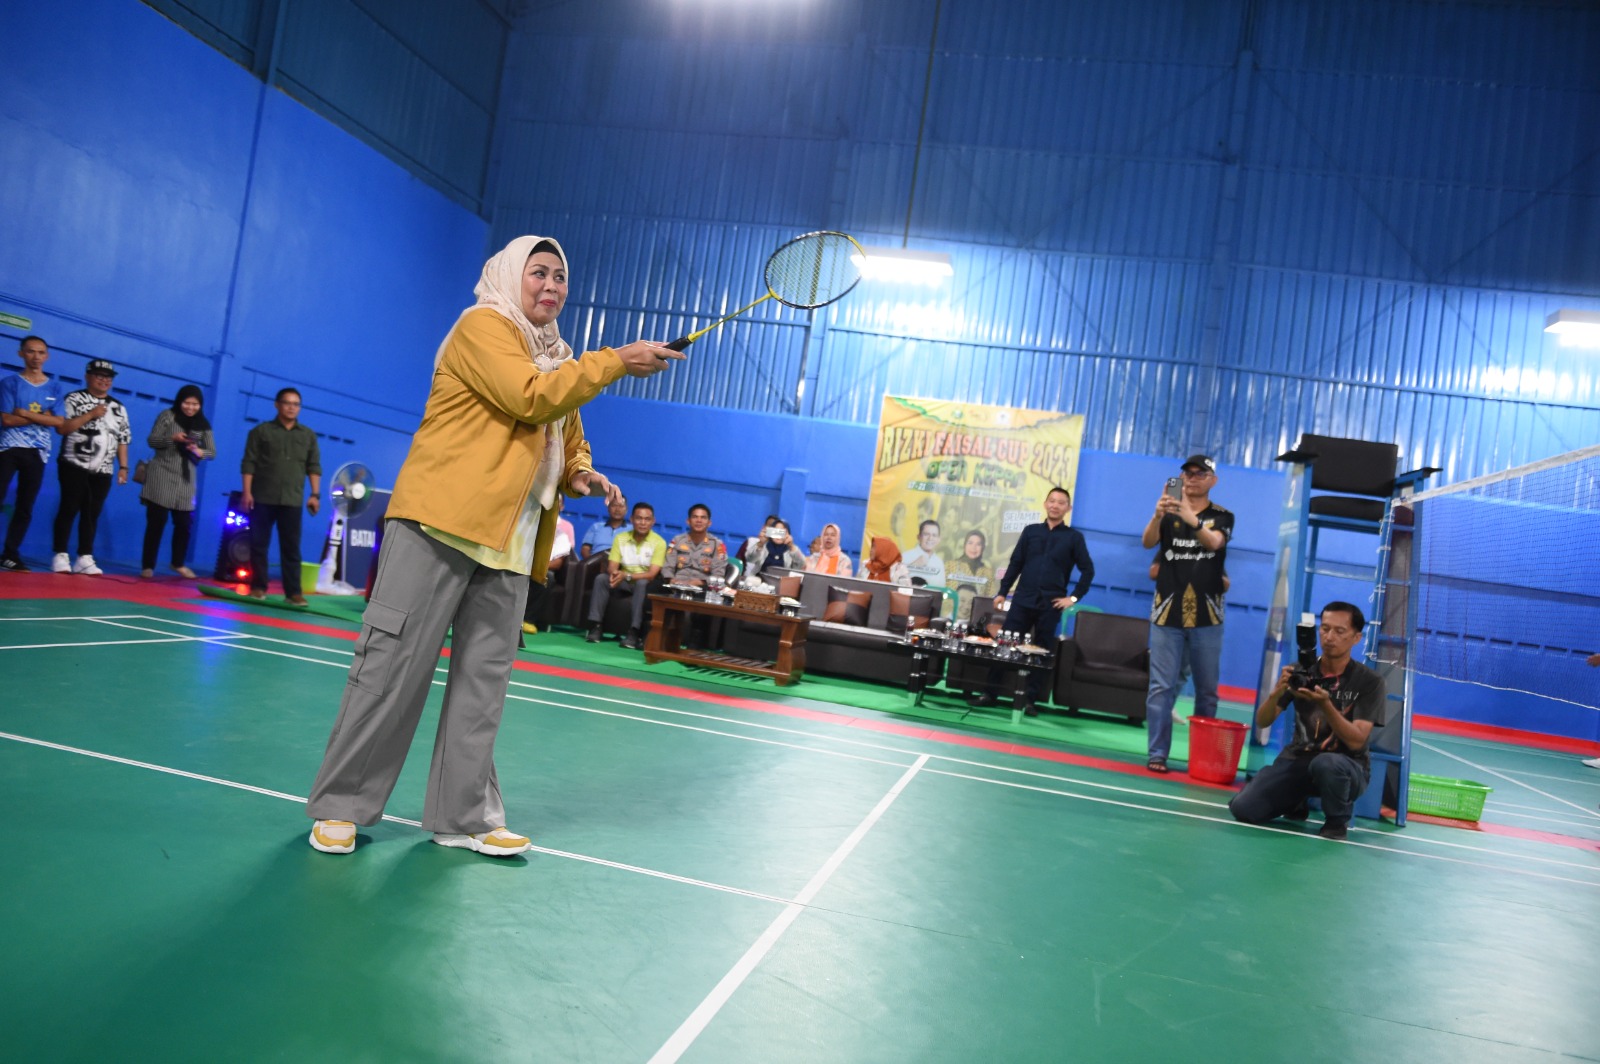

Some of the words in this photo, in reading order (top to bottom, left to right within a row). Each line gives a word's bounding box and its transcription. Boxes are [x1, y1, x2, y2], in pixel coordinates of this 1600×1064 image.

[878, 426, 930, 472] RIZKI
[932, 431, 993, 460] FAISAL
[996, 437, 1029, 467] CUP
[1031, 441, 1073, 487] 2023
[926, 460, 968, 481] OPEN
[1003, 511, 1041, 522] SELAMAT
